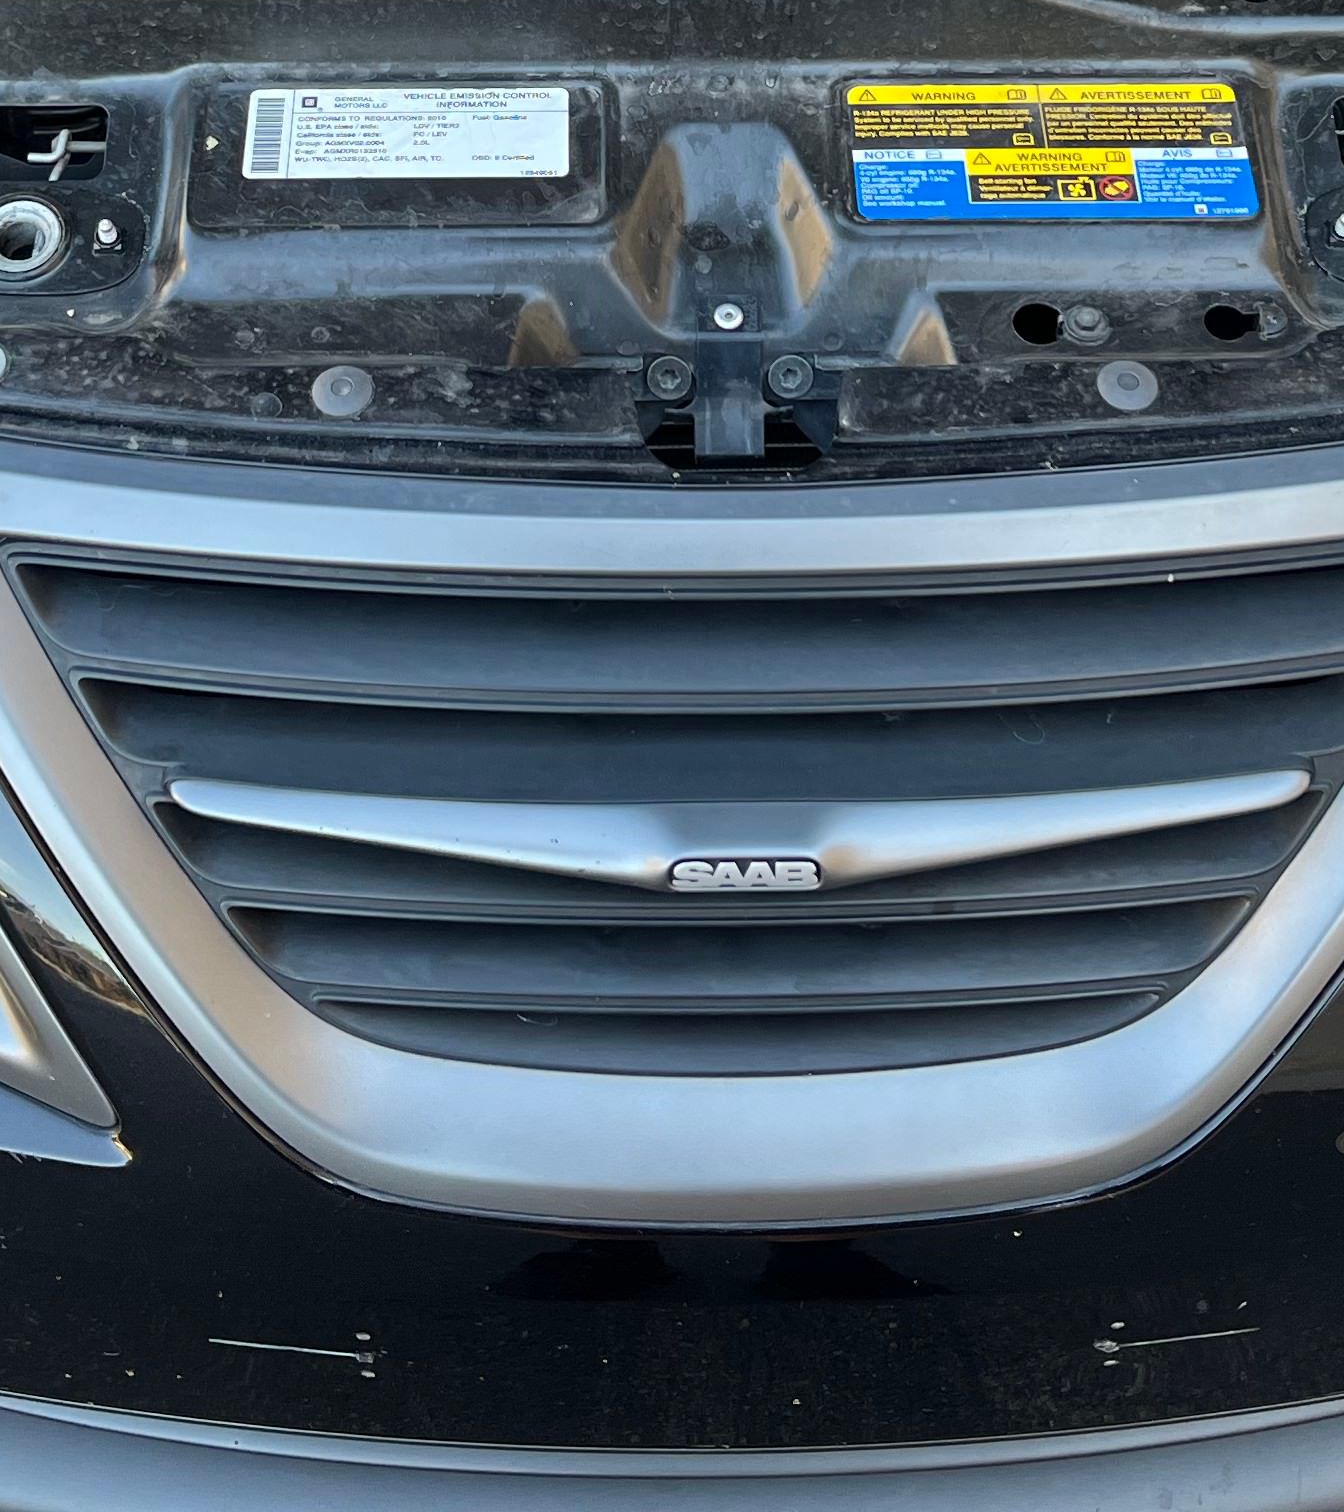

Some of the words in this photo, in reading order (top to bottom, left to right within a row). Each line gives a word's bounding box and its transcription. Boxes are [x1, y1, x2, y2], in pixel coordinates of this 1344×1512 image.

[911, 92, 976, 101] WARNING
[1080, 91, 1192, 100] AVERTISSEMENT
[864, 151, 916, 160] NOTICE
[1016, 153, 1083, 162] WARNING
[1162, 149, 1193, 158] AVIS
[994, 163, 1108, 172] AVERTISSEMENT
[672, 860, 819, 888] SAAB
